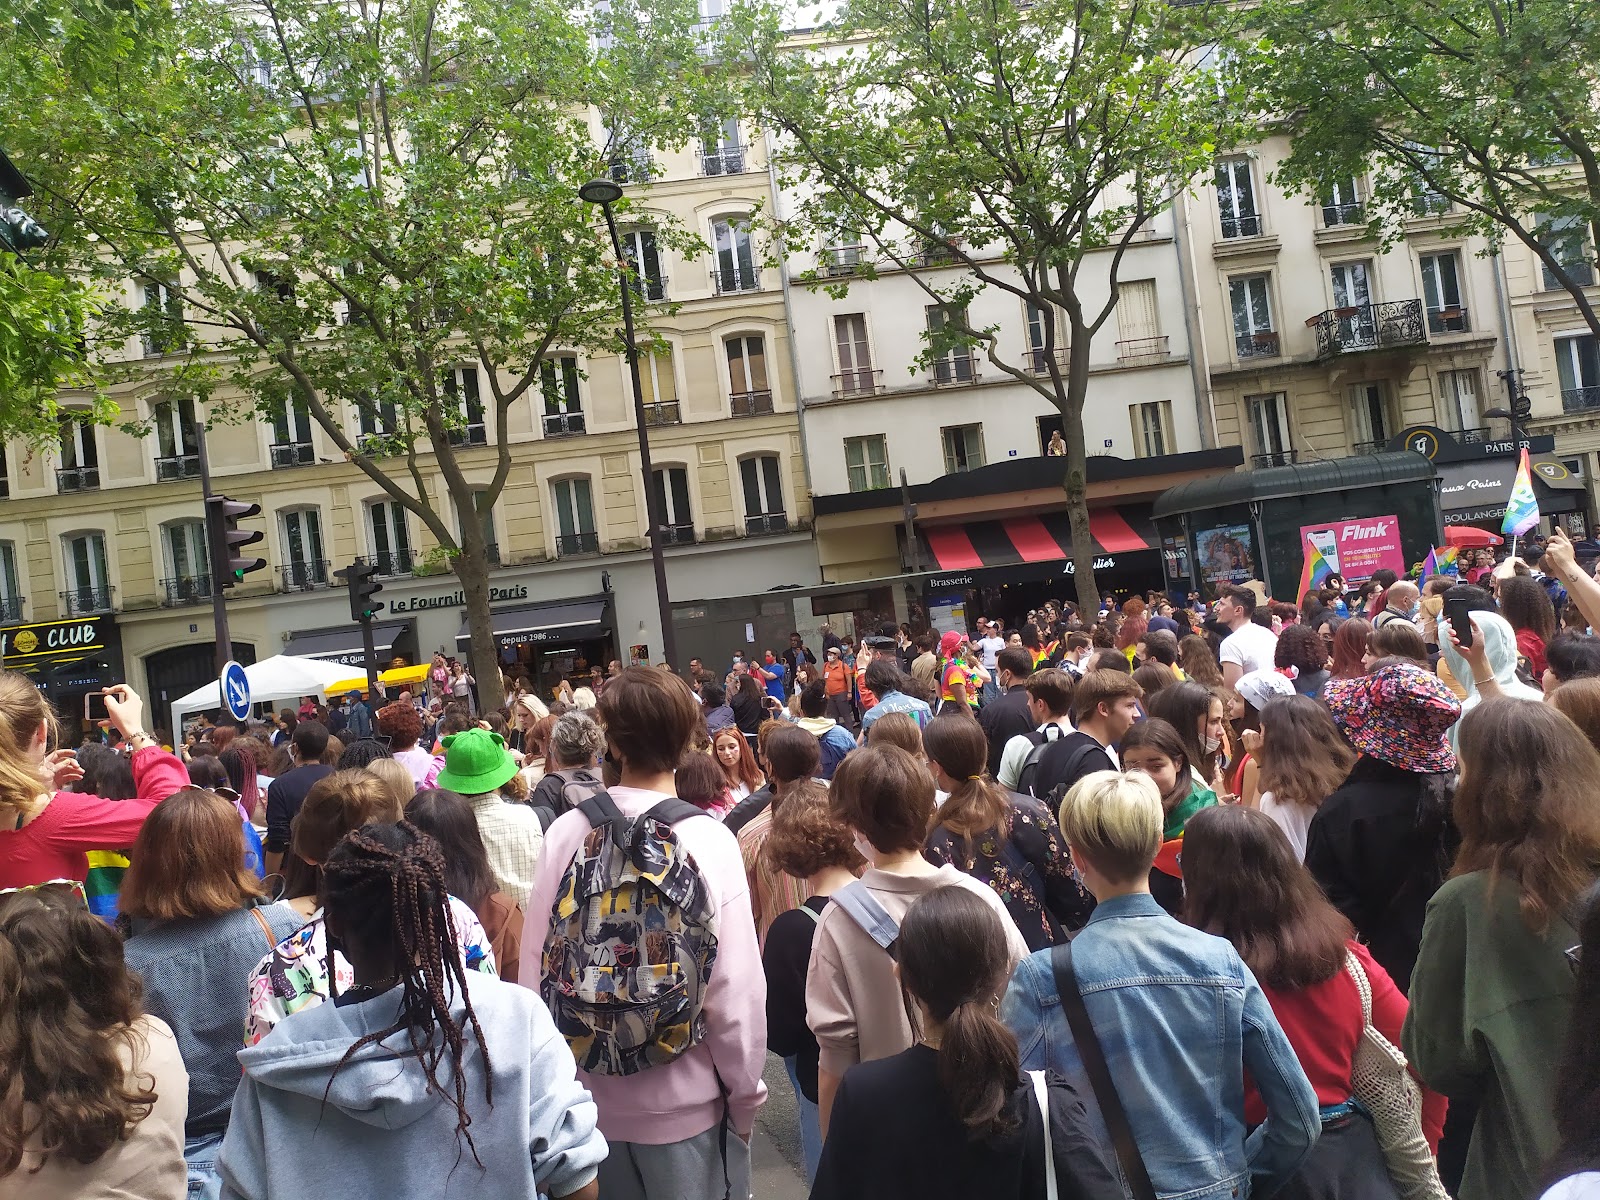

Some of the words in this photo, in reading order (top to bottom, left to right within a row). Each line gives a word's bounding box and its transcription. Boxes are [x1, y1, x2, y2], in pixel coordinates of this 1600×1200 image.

[1441, 485, 1466, 493] aux
[1467, 479, 1502, 490] Pains
[1341, 522, 1388, 541] Flink
[930, 575, 973, 588] Brasserie
[390, 600, 406, 614] Le
[410, 591, 464, 611] Fournil
[489, 584, 528, 601] Paris
[47, 624, 96, 648] CLUB
[501, 634, 528, 645] depuis
[529, 633, 547, 642] 1986
[340, 655, 349, 664] &
